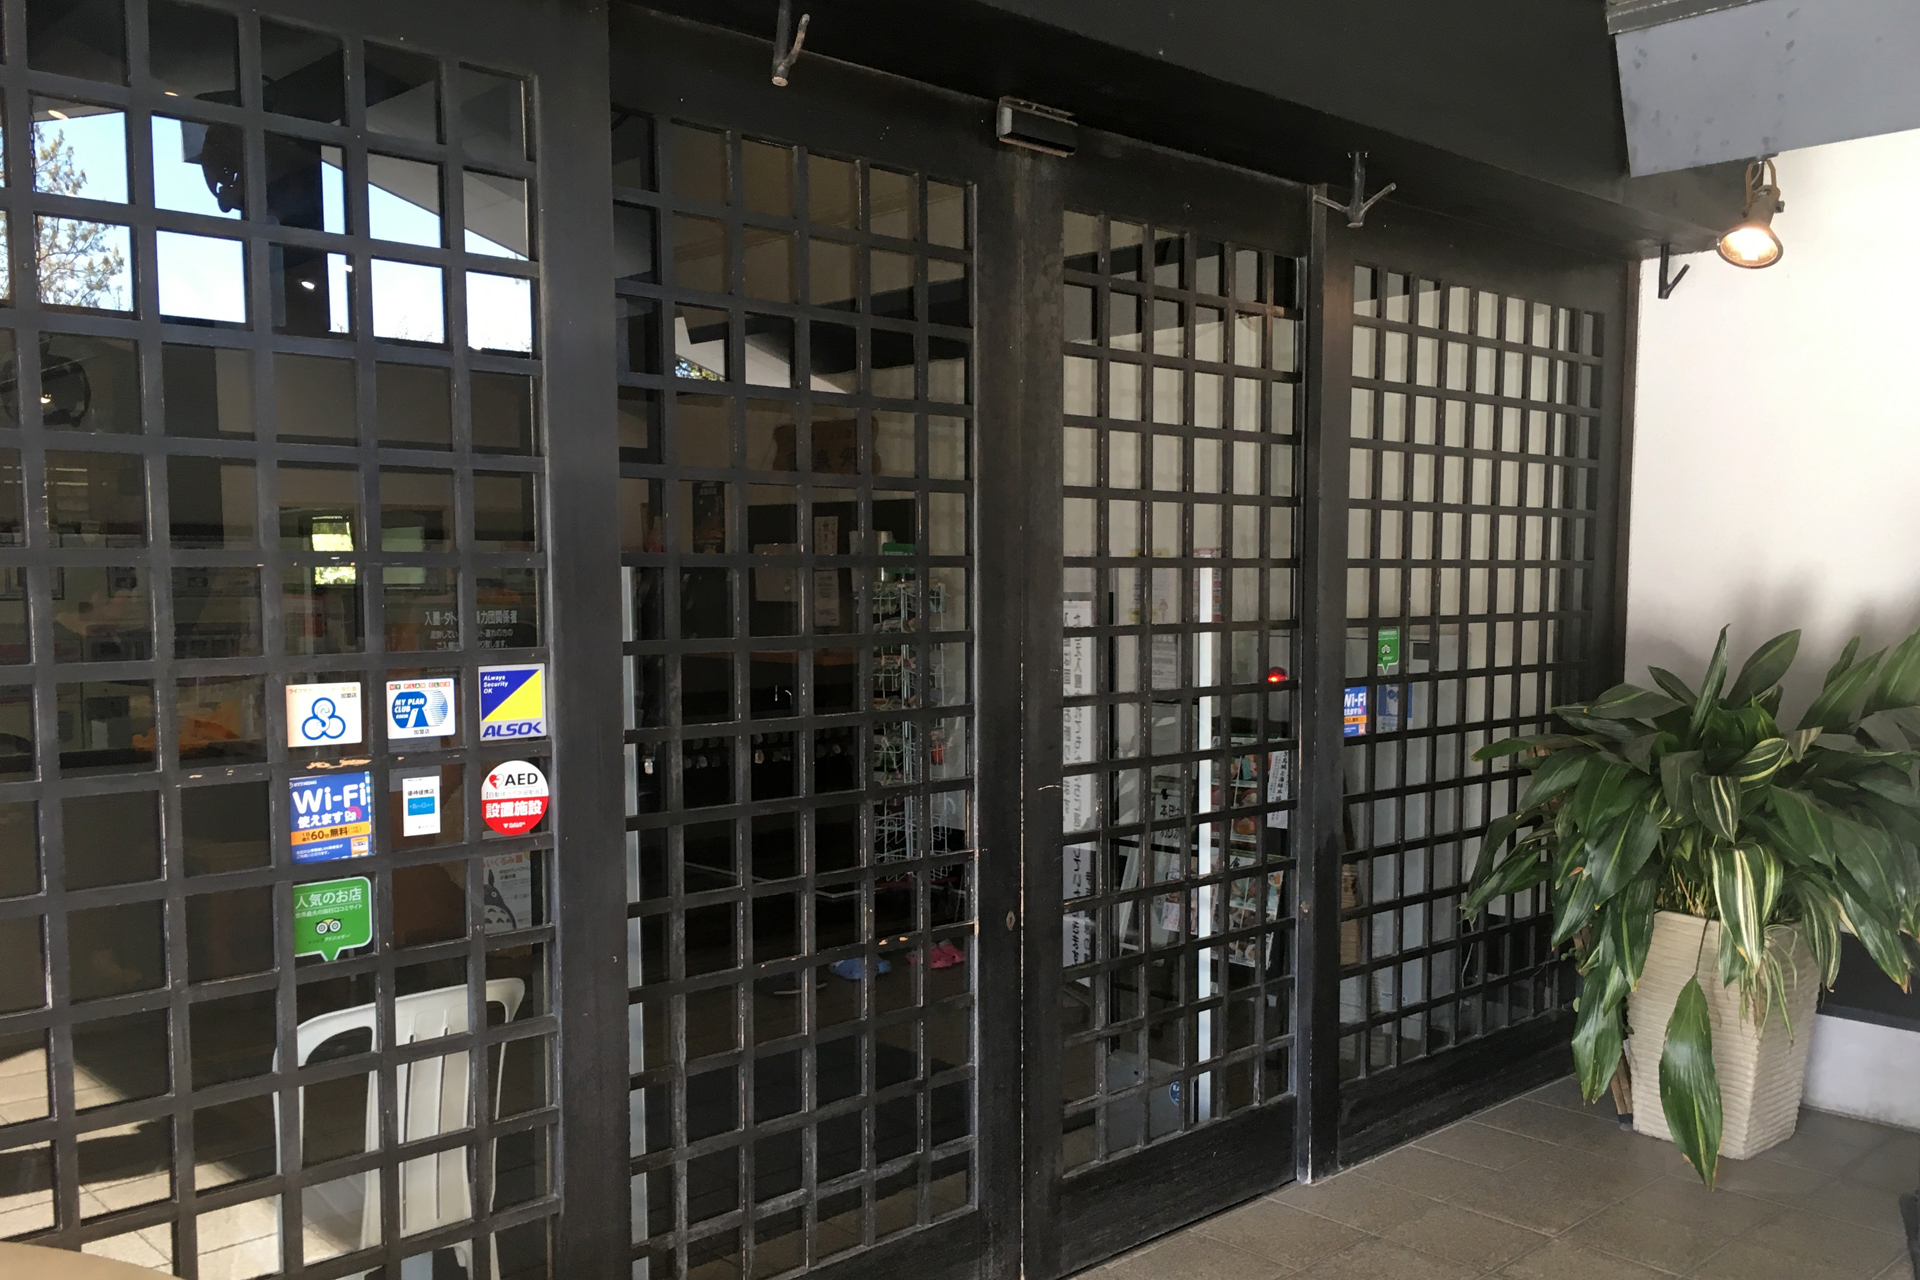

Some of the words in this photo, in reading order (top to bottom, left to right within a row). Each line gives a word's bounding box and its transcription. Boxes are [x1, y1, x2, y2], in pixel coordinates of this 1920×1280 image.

[394, 705, 411, 713] CLUB
[407, 698, 425, 706] PLAN
[482, 721, 542, 738] ALSOK
[504, 773, 538, 786] AED
[292, 782, 367, 814] Wi-Fi
[485, 800, 542, 819] 設置施設
[297, 811, 343, 829] 使えます
[295, 888, 362, 909] 人気のお店
